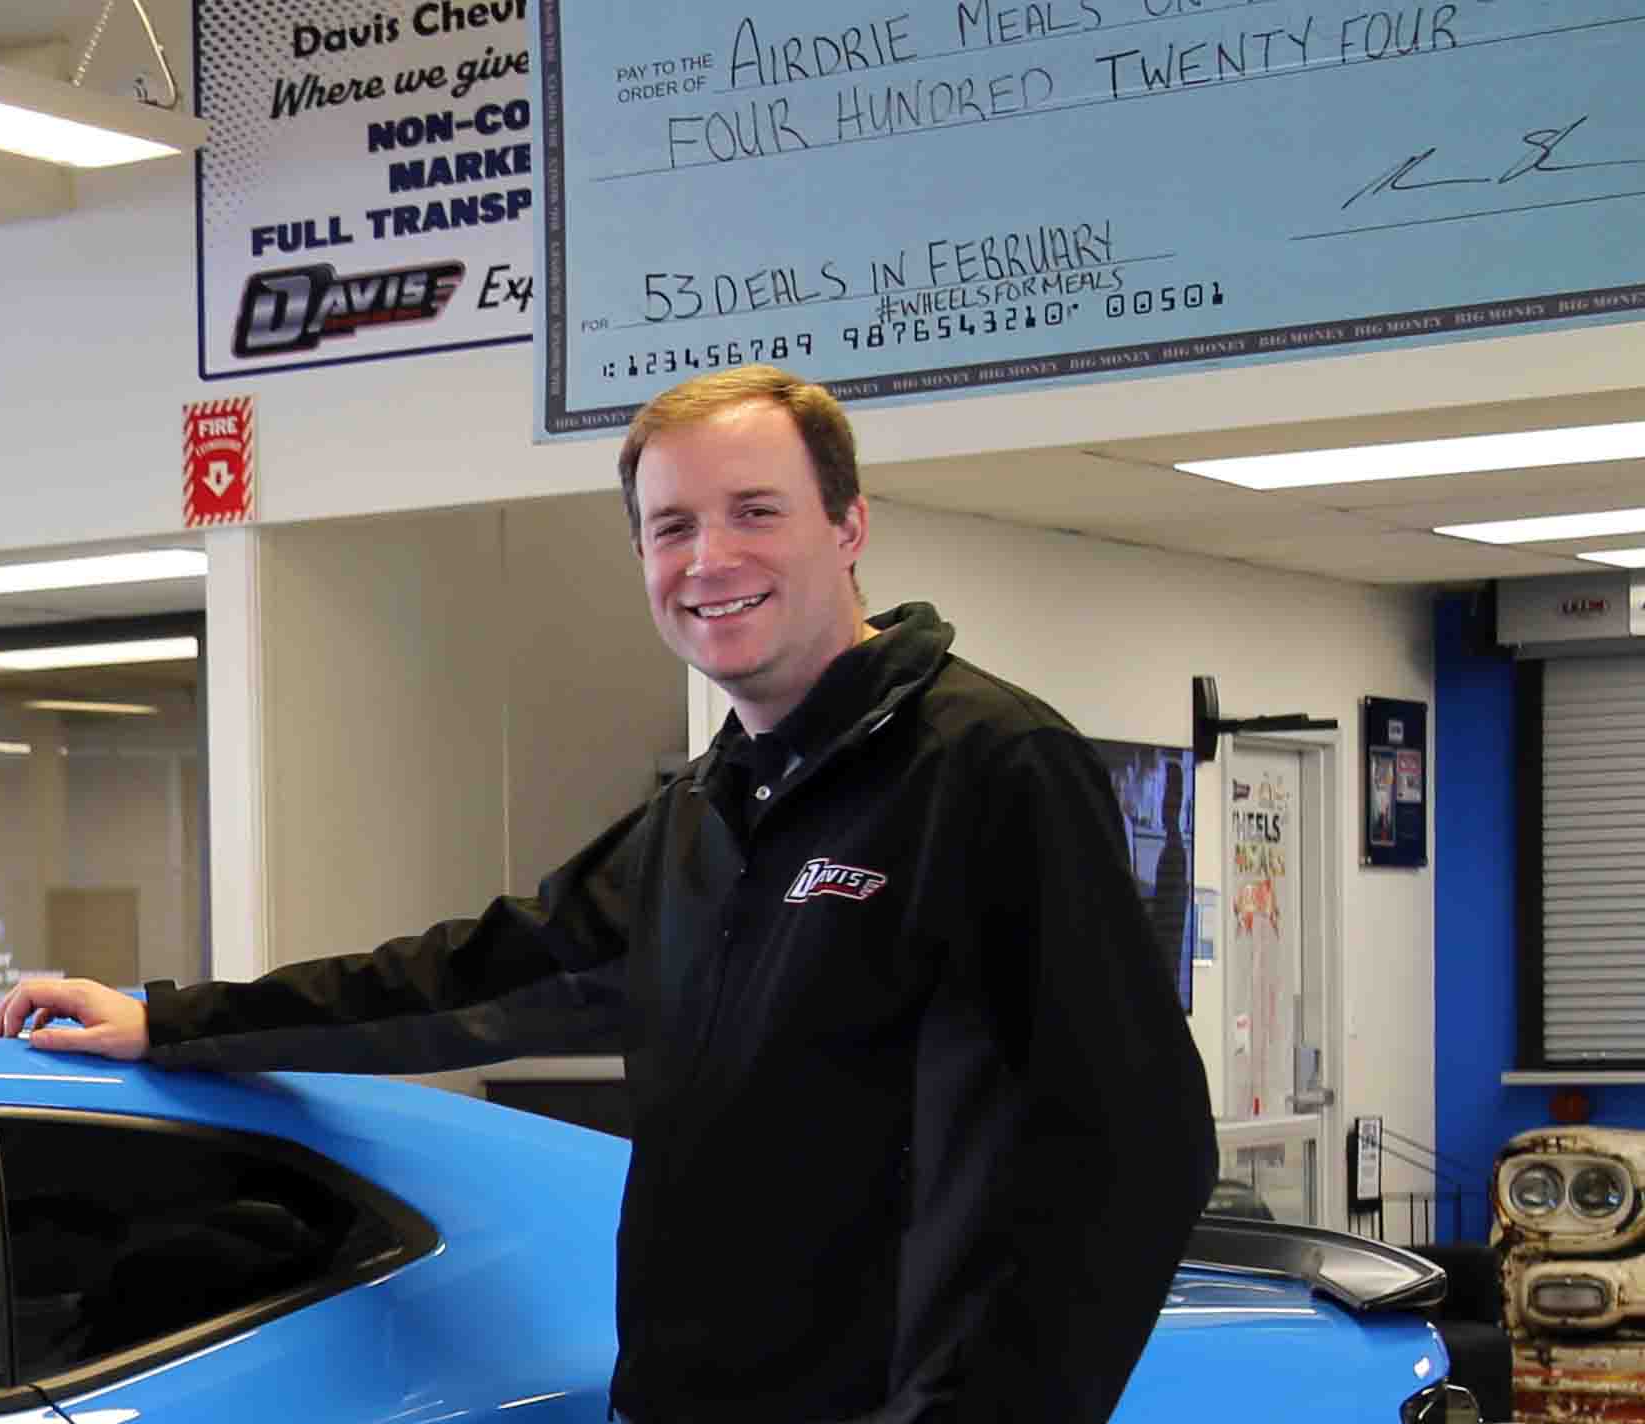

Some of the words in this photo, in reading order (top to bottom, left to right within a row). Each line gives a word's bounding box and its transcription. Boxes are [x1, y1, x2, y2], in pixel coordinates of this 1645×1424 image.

[293, 13, 399, 58] Davis
[730, 14, 918, 88] AIRDRIE
[958, 0, 1102, 46] MEALS
[270, 72, 386, 120] Where
[395, 63, 448, 95] we
[451, 46, 530, 99] give
[616, 64, 648, 83] PAY
[652, 60, 676, 78] TO
[680, 53, 714, 70] THE
[617, 77, 678, 103] ORDER
[683, 75, 708, 93] OF
[668, 97, 810, 169] FOUR
[837, 67, 1054, 142] HUNDRED
[1095, 16, 1313, 99] TWENTY
[1341, 3, 1457, 63] FOUR
[368, 99, 531, 152] NON-CO
[389, 143, 532, 194] MARKE
[251, 216, 354, 257] FULL
[365, 188, 532, 239] TRANSP
[645, 272, 704, 324] 53
[715, 260, 848, 316] DEALS
[870, 250, 907, 295] IN
[928, 219, 1114, 287] FEBRUARY
[876, 266, 1124, 325] #WHEELSFORMEALS
[243, 270, 431, 350] DAVIS
[581, 317, 609, 334] FOR
[1106, 281, 1225, 318] 00501
[197, 415, 239, 439] FIRE
[788, 860, 869, 900] DAVIS
